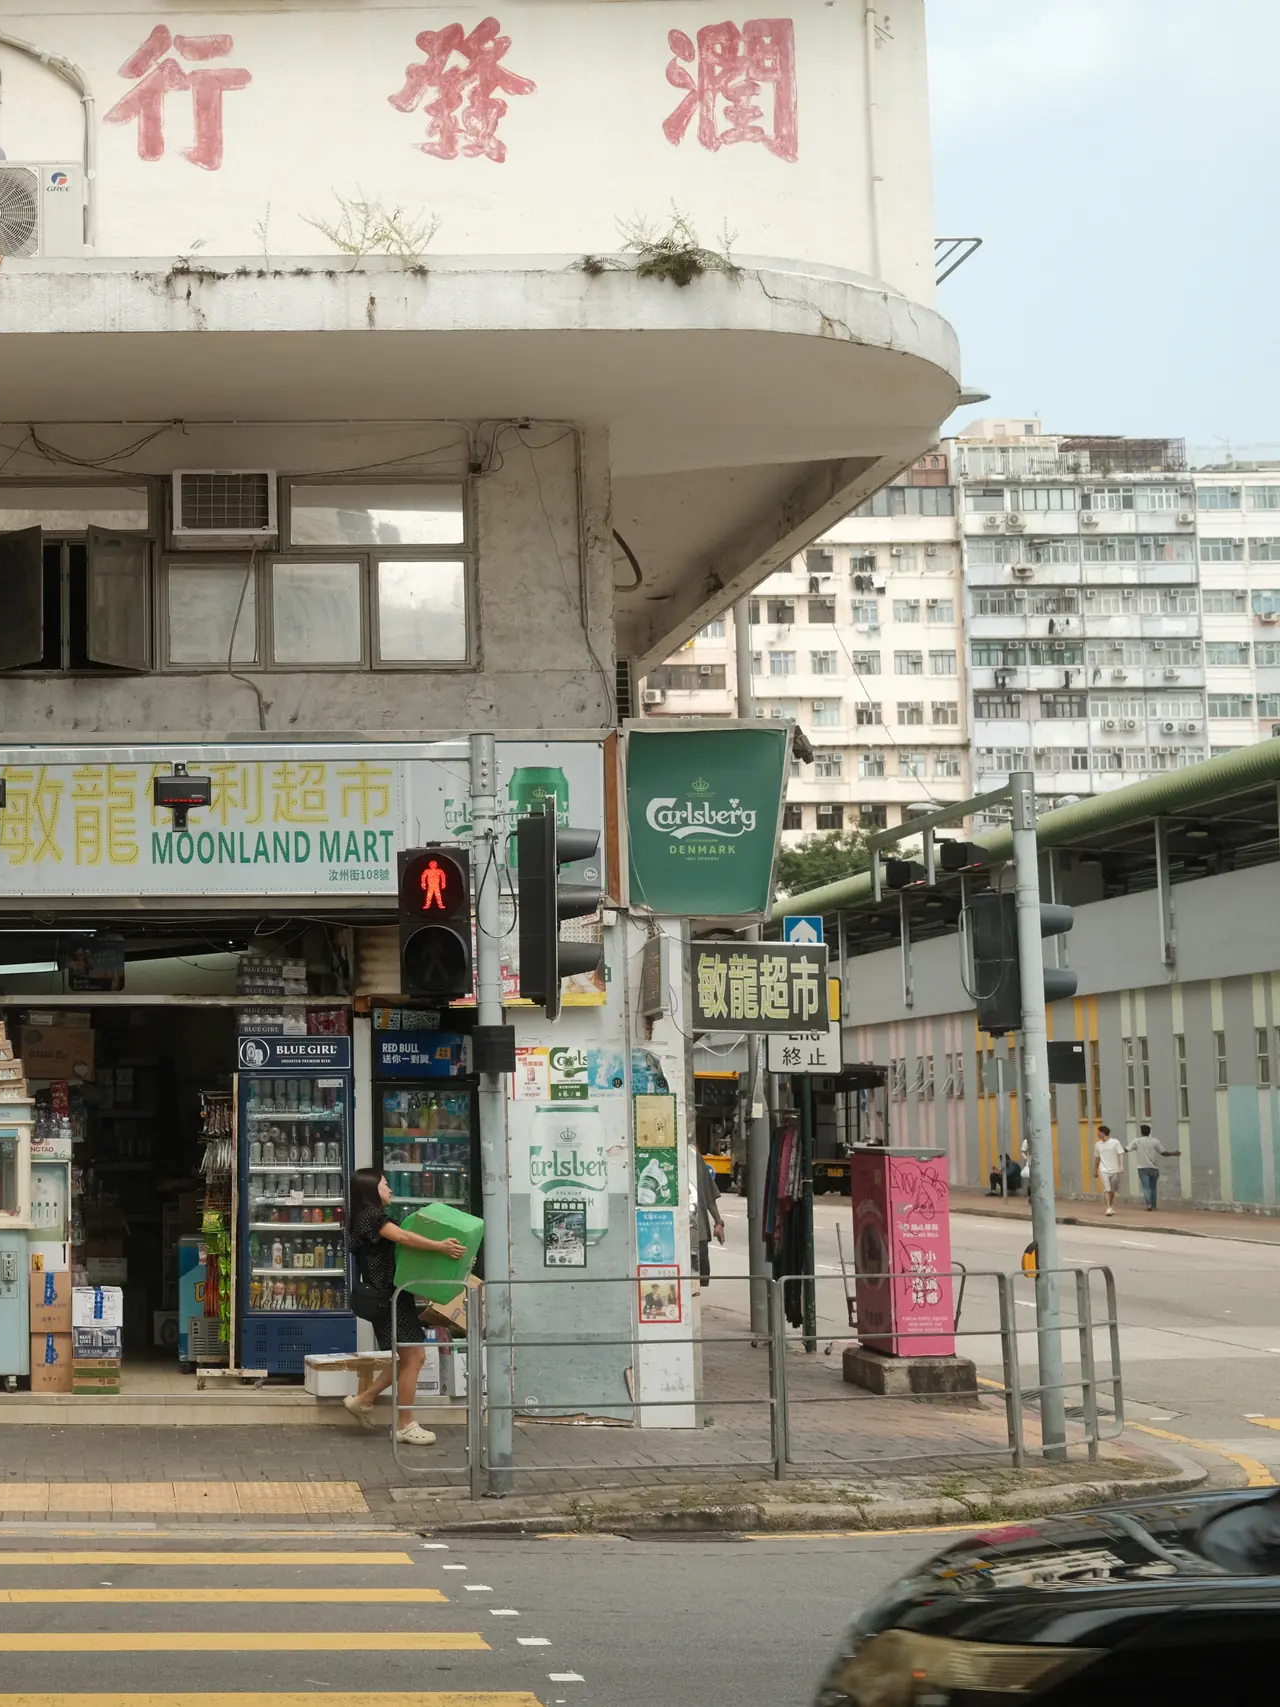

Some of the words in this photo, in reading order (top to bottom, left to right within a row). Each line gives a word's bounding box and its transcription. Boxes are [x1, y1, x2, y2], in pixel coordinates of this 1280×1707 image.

[646, 797, 757, 833] Carlsberg
[152, 831, 311, 865] MOONLAND
[320, 829, 393, 863] MART
[669, 845, 736, 854] DENMARK
[328, 868, 390, 882] 汝州街108號
[697, 952, 820, 1021] 敏龍超市
[276, 1045, 306, 1055] BLUE
[382, 1043, 398, 1053] RED
[399, 1043, 419, 1053] BULL
[782, 1047, 827, 1067] 終止
